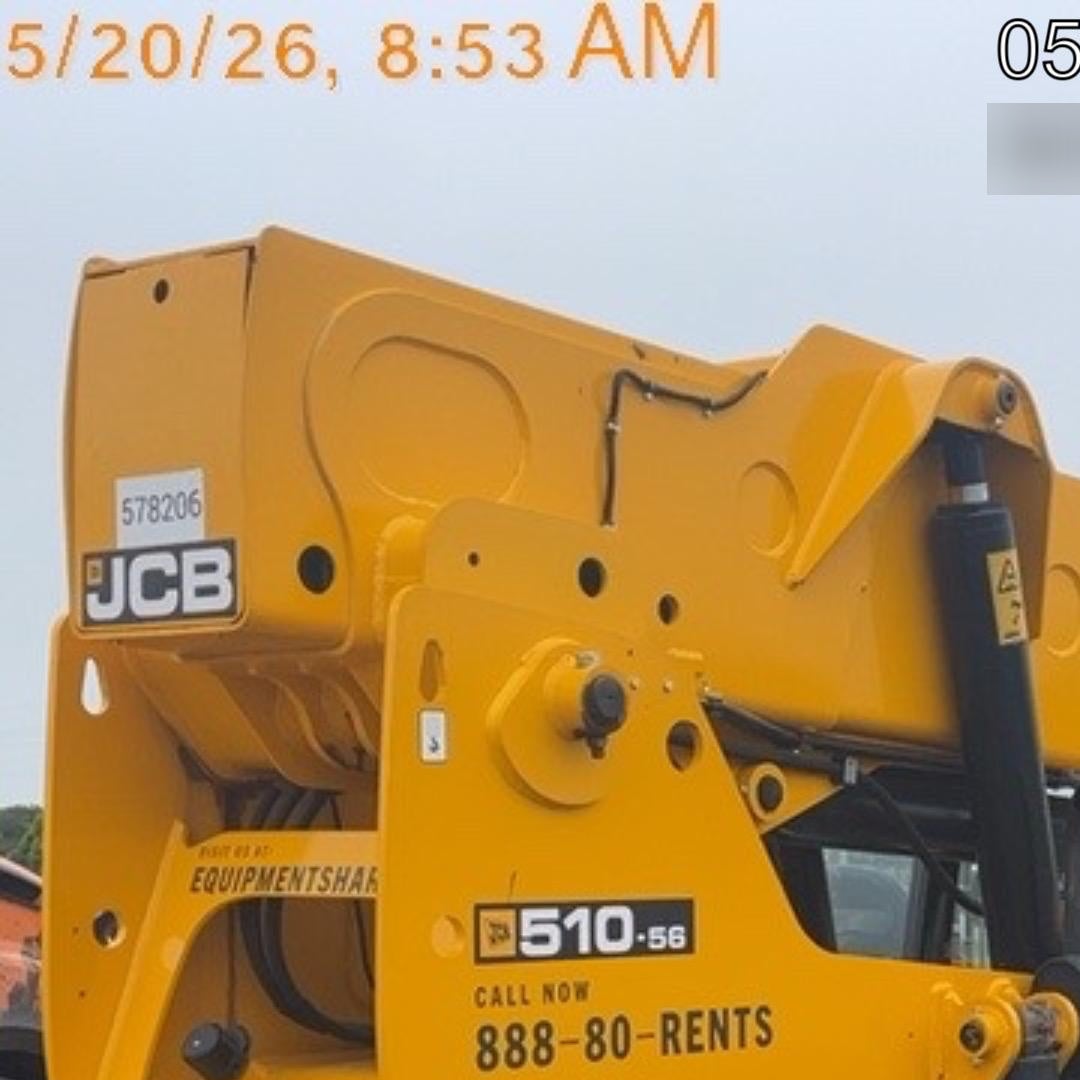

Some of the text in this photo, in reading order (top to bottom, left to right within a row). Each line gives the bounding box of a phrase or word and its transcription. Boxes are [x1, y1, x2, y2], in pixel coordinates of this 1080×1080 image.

[121, 488, 201, 526] 578206
[86, 547, 234, 621] JCB
[474, 981, 591, 1008] CALL NOW
[476, 1005, 773, 1072] 888-80-RENTS
